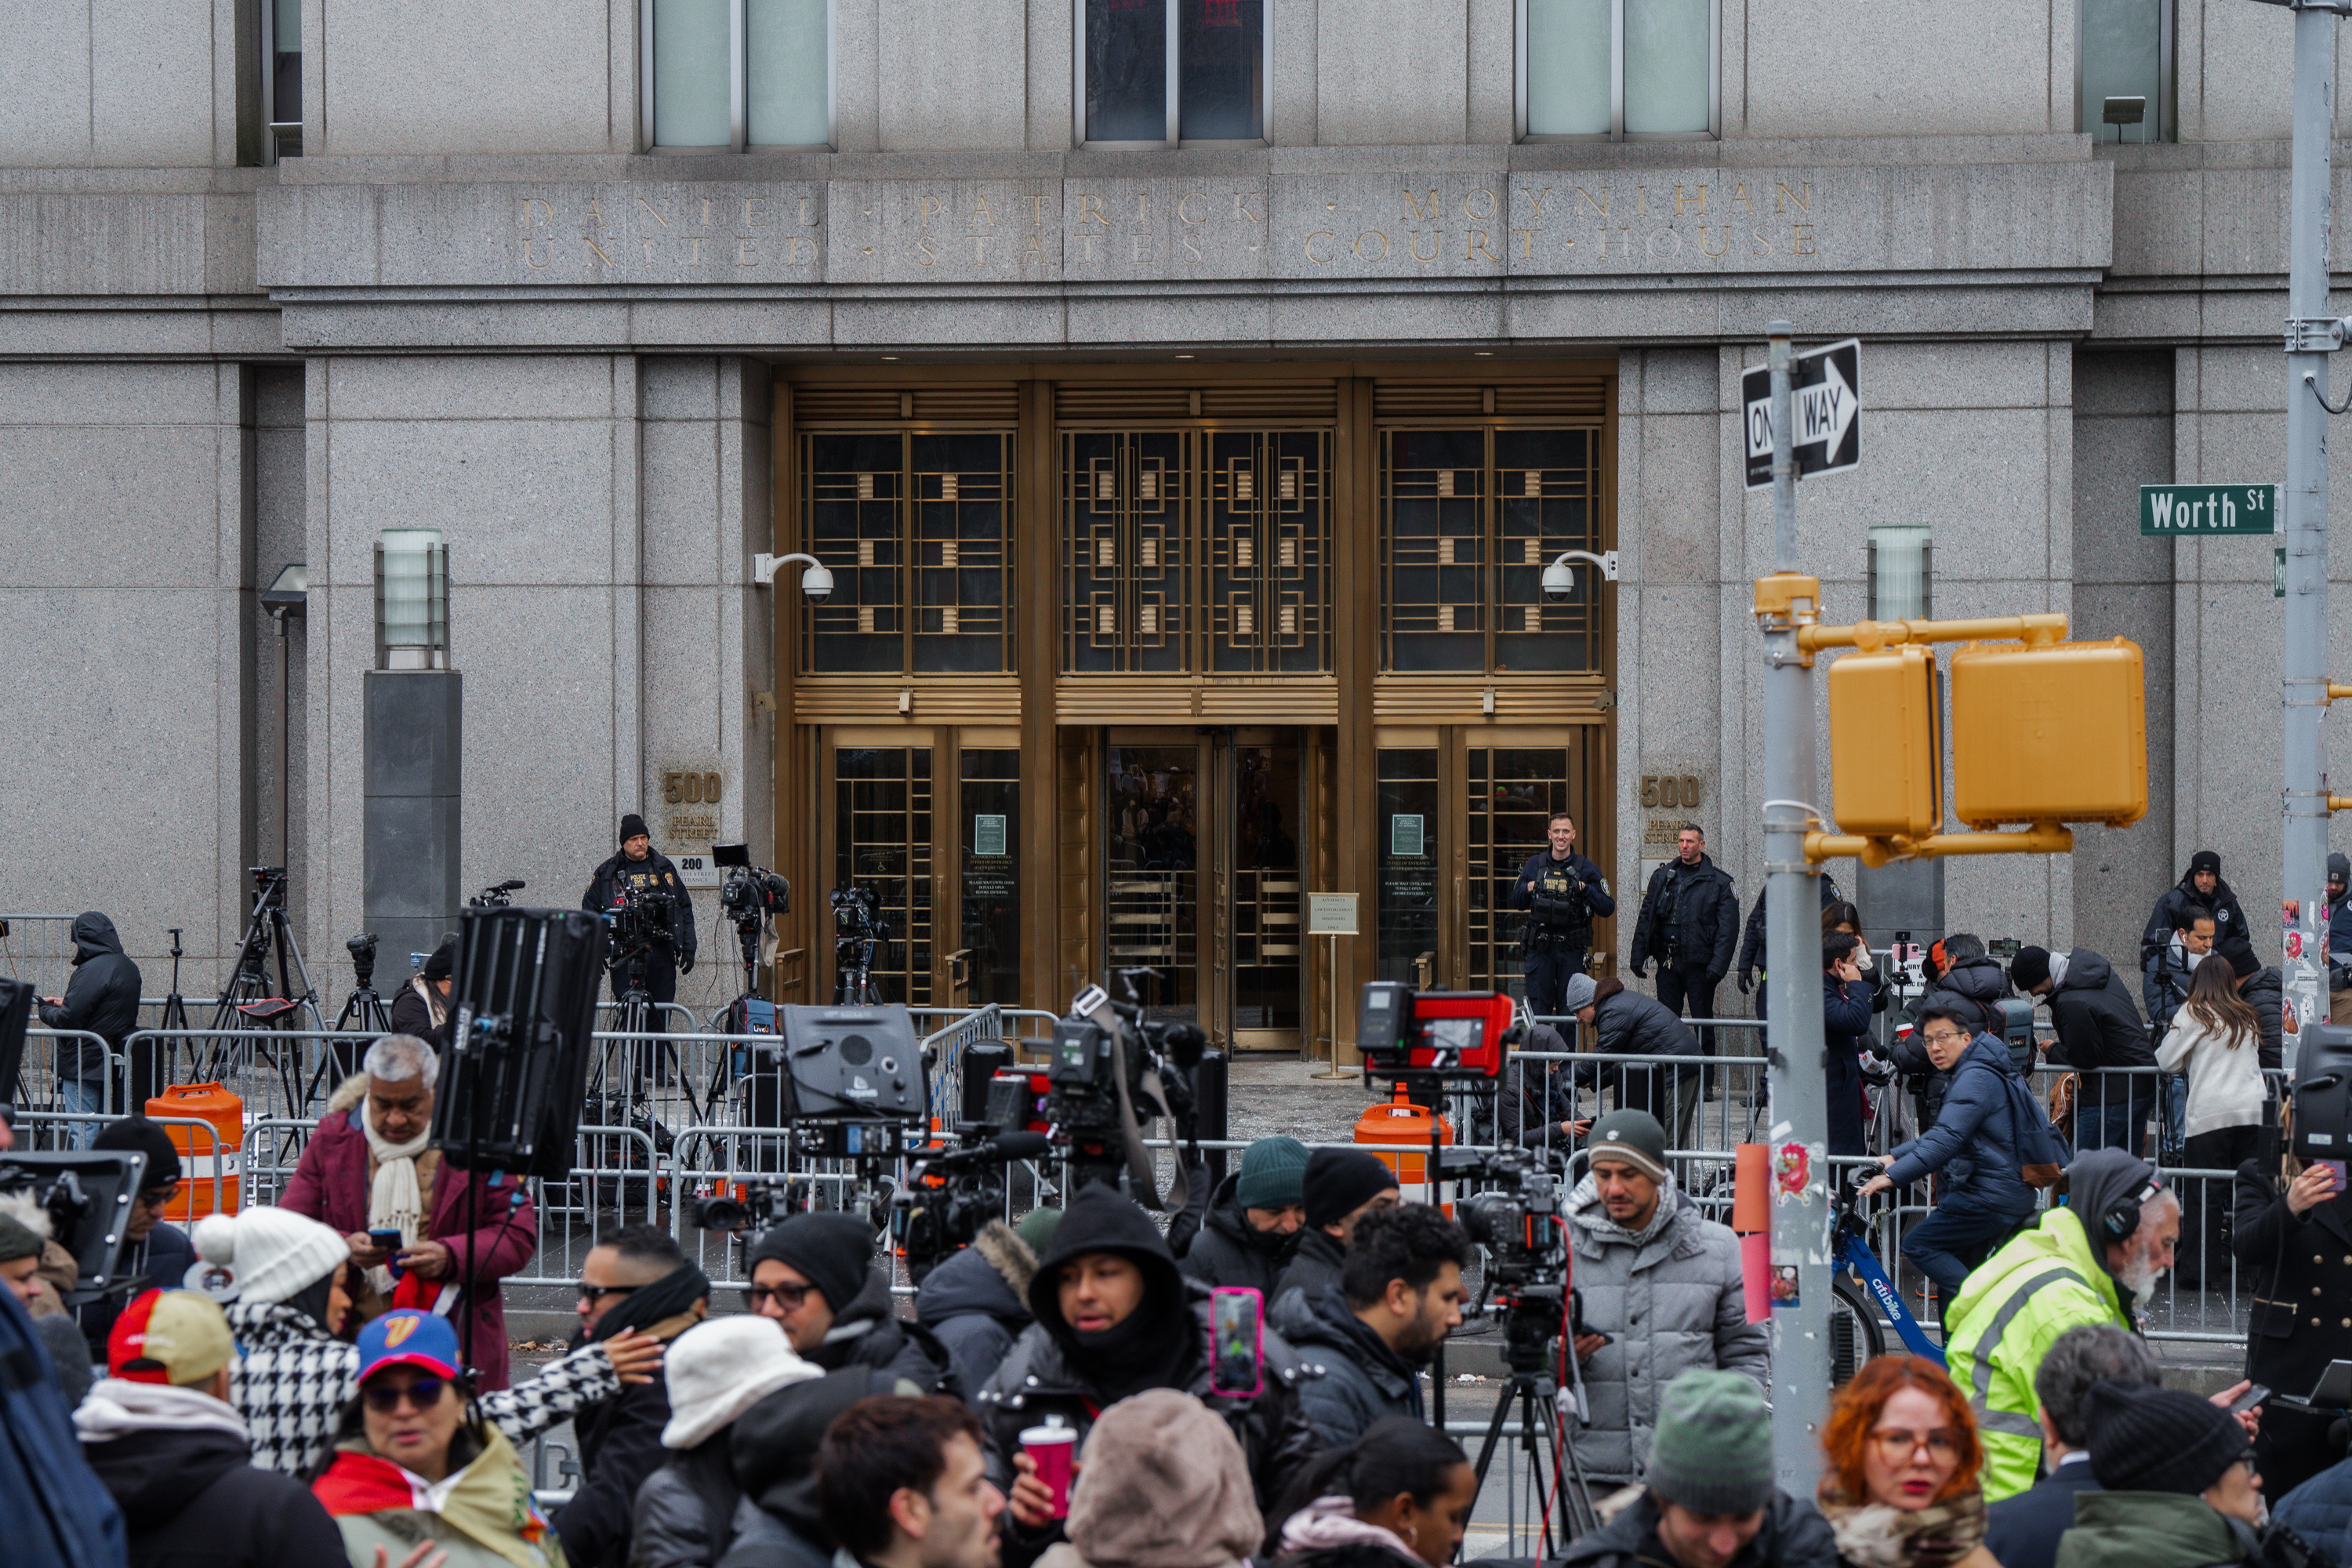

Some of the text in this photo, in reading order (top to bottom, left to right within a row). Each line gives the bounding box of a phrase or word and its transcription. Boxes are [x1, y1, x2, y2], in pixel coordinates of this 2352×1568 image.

[521, 182, 1813, 229] DANIEL PATRICK MOYNIHAN
[521, 224, 1817, 269] UNITED STATES COURT HOUSE
[1752, 386, 1842, 449] ON WAY
[2151, 488, 2265, 528] Worth St
[666, 771, 722, 803] 500
[1641, 775, 1699, 808] 500
[669, 828, 718, 840] STREET
[673, 816, 715, 826] PEARL
[1648, 819, 1688, 830] PEAR
[1644, 833, 1679, 844] STRE
[681, 858, 702, 870] 200
